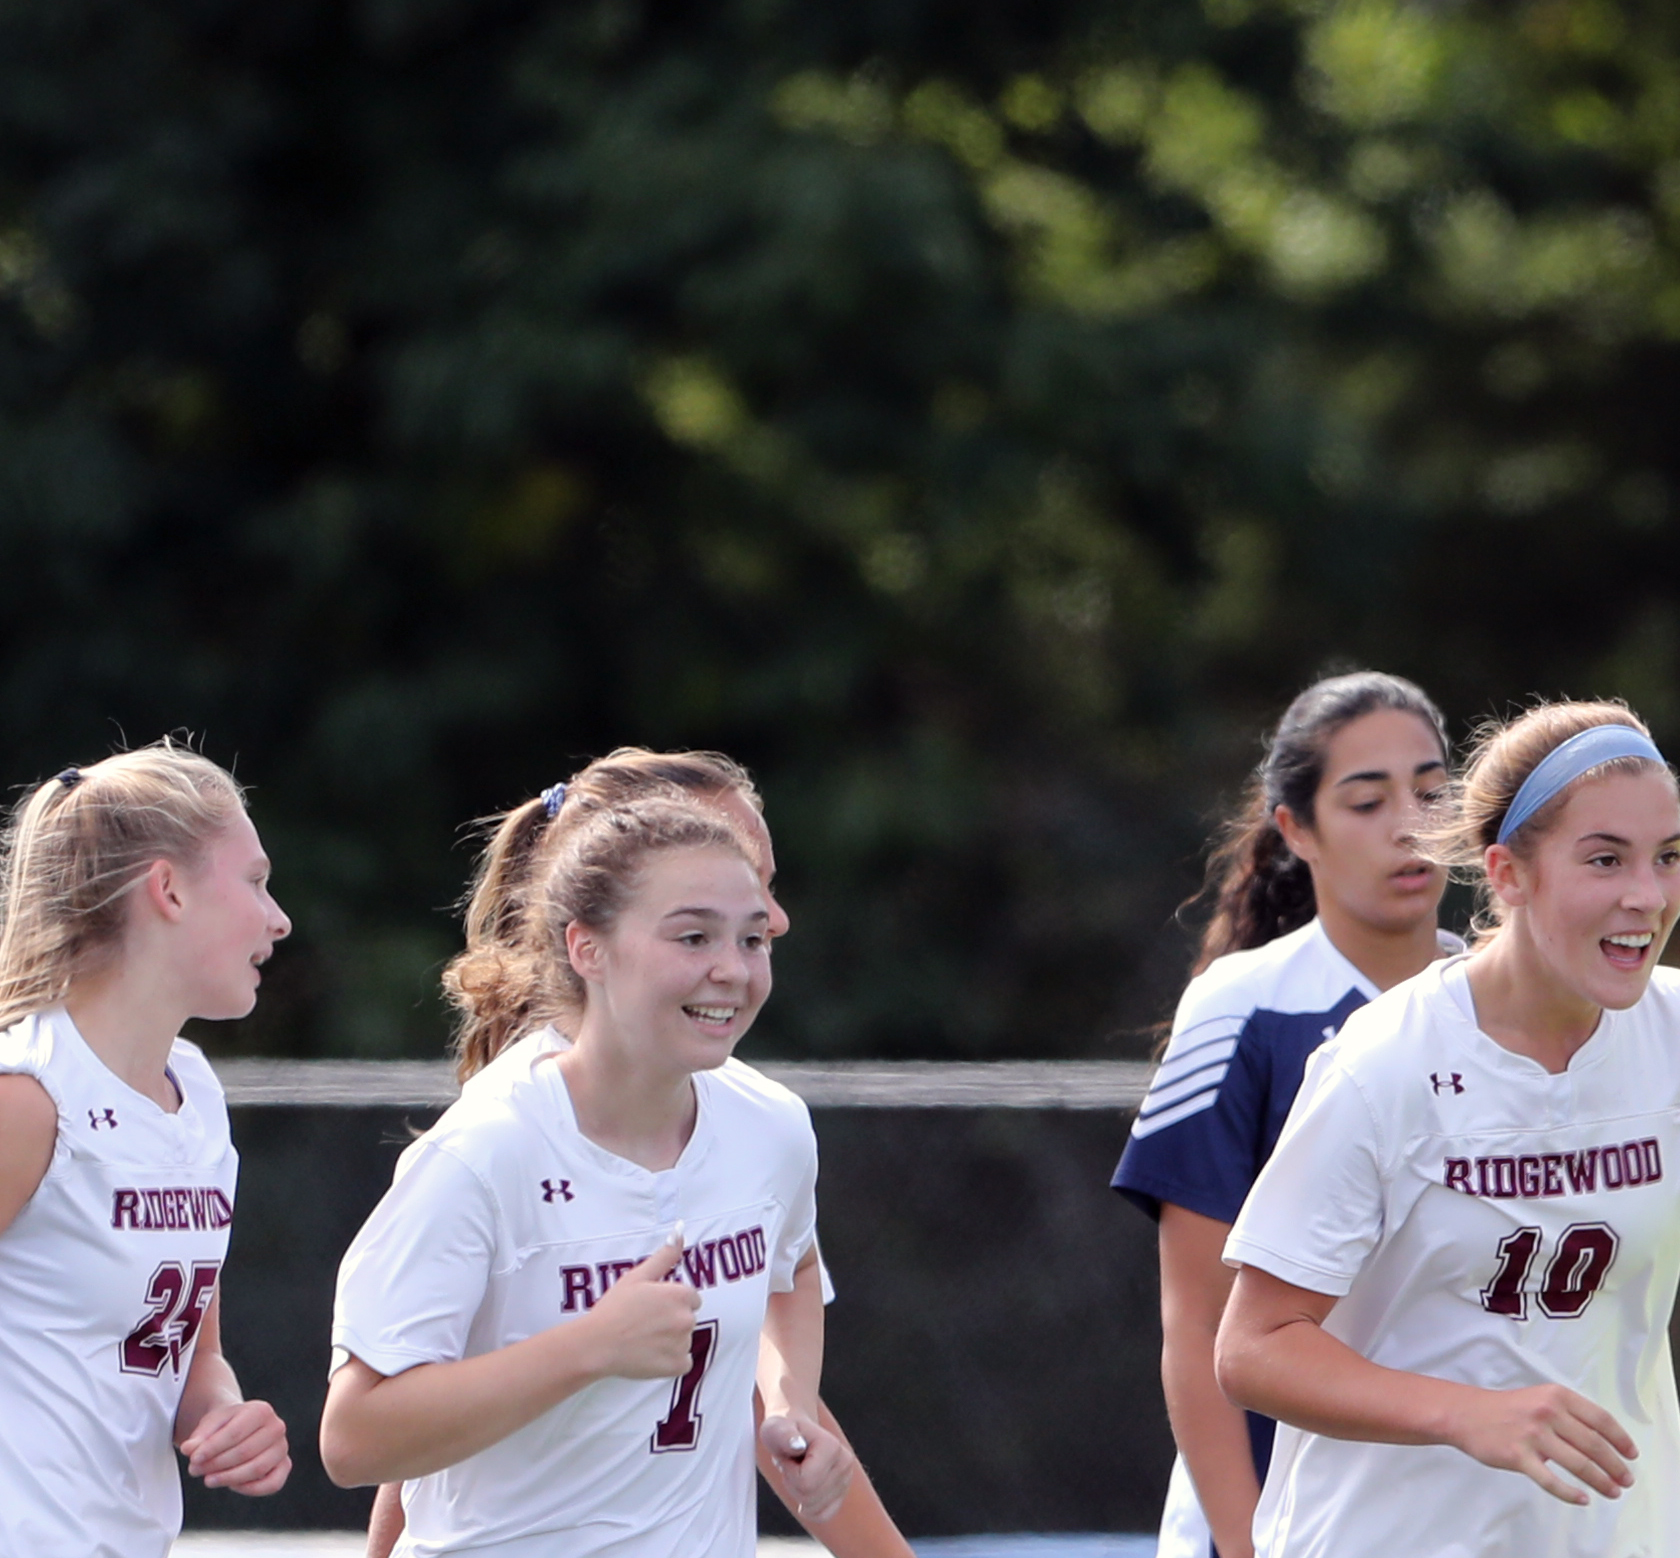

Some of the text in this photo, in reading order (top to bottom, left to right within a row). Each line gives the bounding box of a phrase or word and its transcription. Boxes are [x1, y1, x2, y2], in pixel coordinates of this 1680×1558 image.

[1444, 1136, 1663, 1200] RIDGEWOOD
[118, 1259, 221, 1378] 25
[1480, 1221, 1620, 1321] 10
